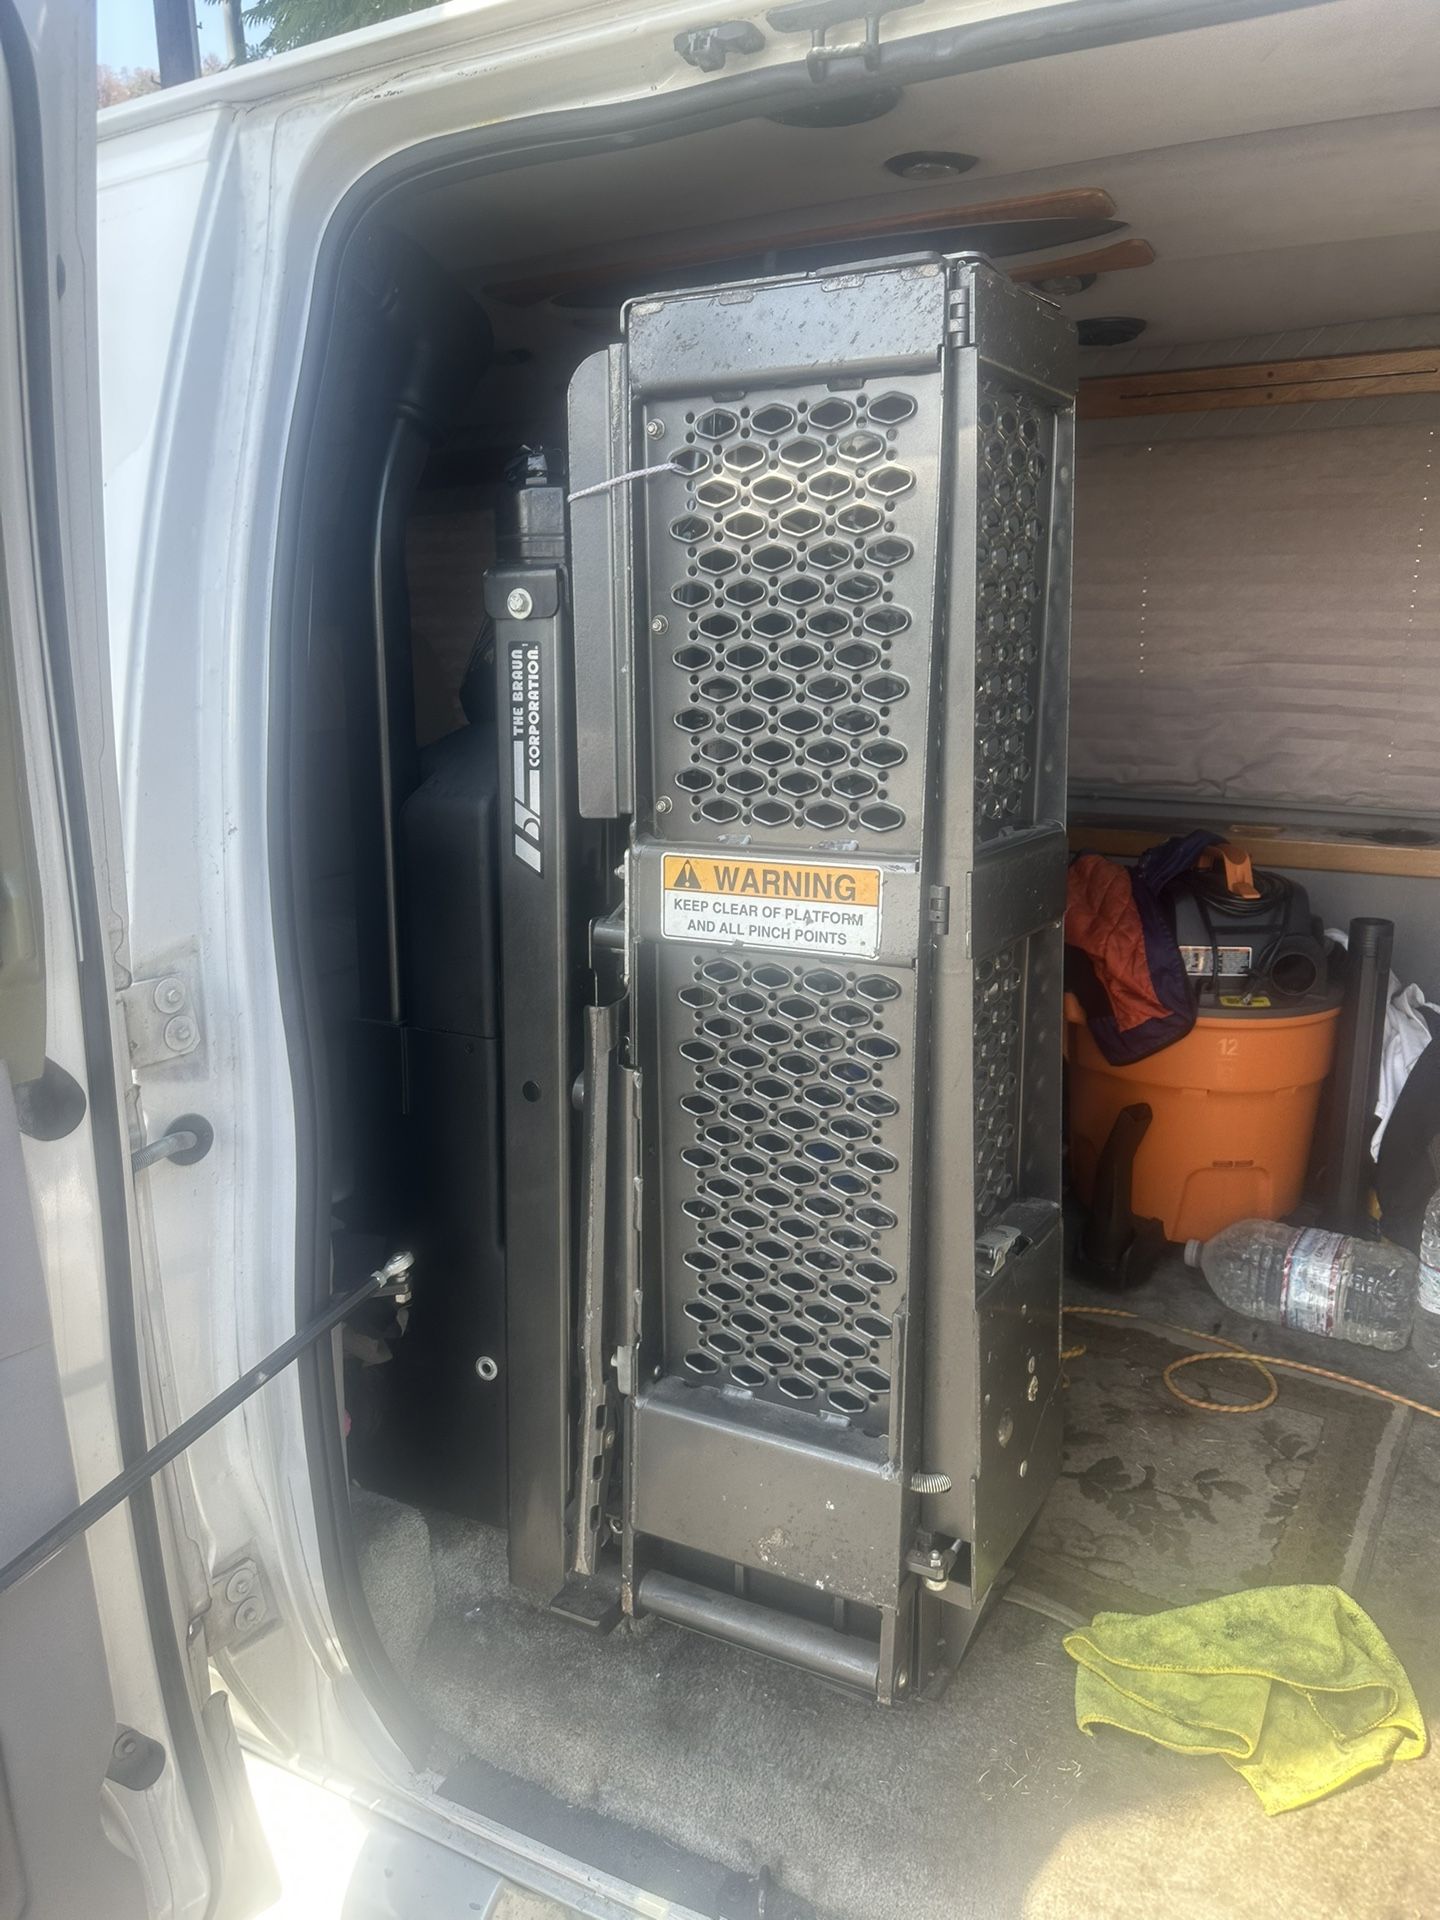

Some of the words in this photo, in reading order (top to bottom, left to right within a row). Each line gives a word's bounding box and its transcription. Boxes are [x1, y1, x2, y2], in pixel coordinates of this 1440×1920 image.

[511, 649, 524, 701] BRAUN
[513, 707, 524, 736] THE
[713, 865, 856, 901] WARNING
[674, 898, 709, 913] KEEP
[712, 902, 758, 917] CLEAR
[763, 905, 781, 919] OF
[785, 907, 863, 927] PLATFORM
[687, 919, 716, 933] AND
[719, 922, 745, 935] ALL
[749, 924, 790, 940] PINCH
[795, 929, 847, 945] POINTS
[1216, 1038, 1240, 1056] 12
